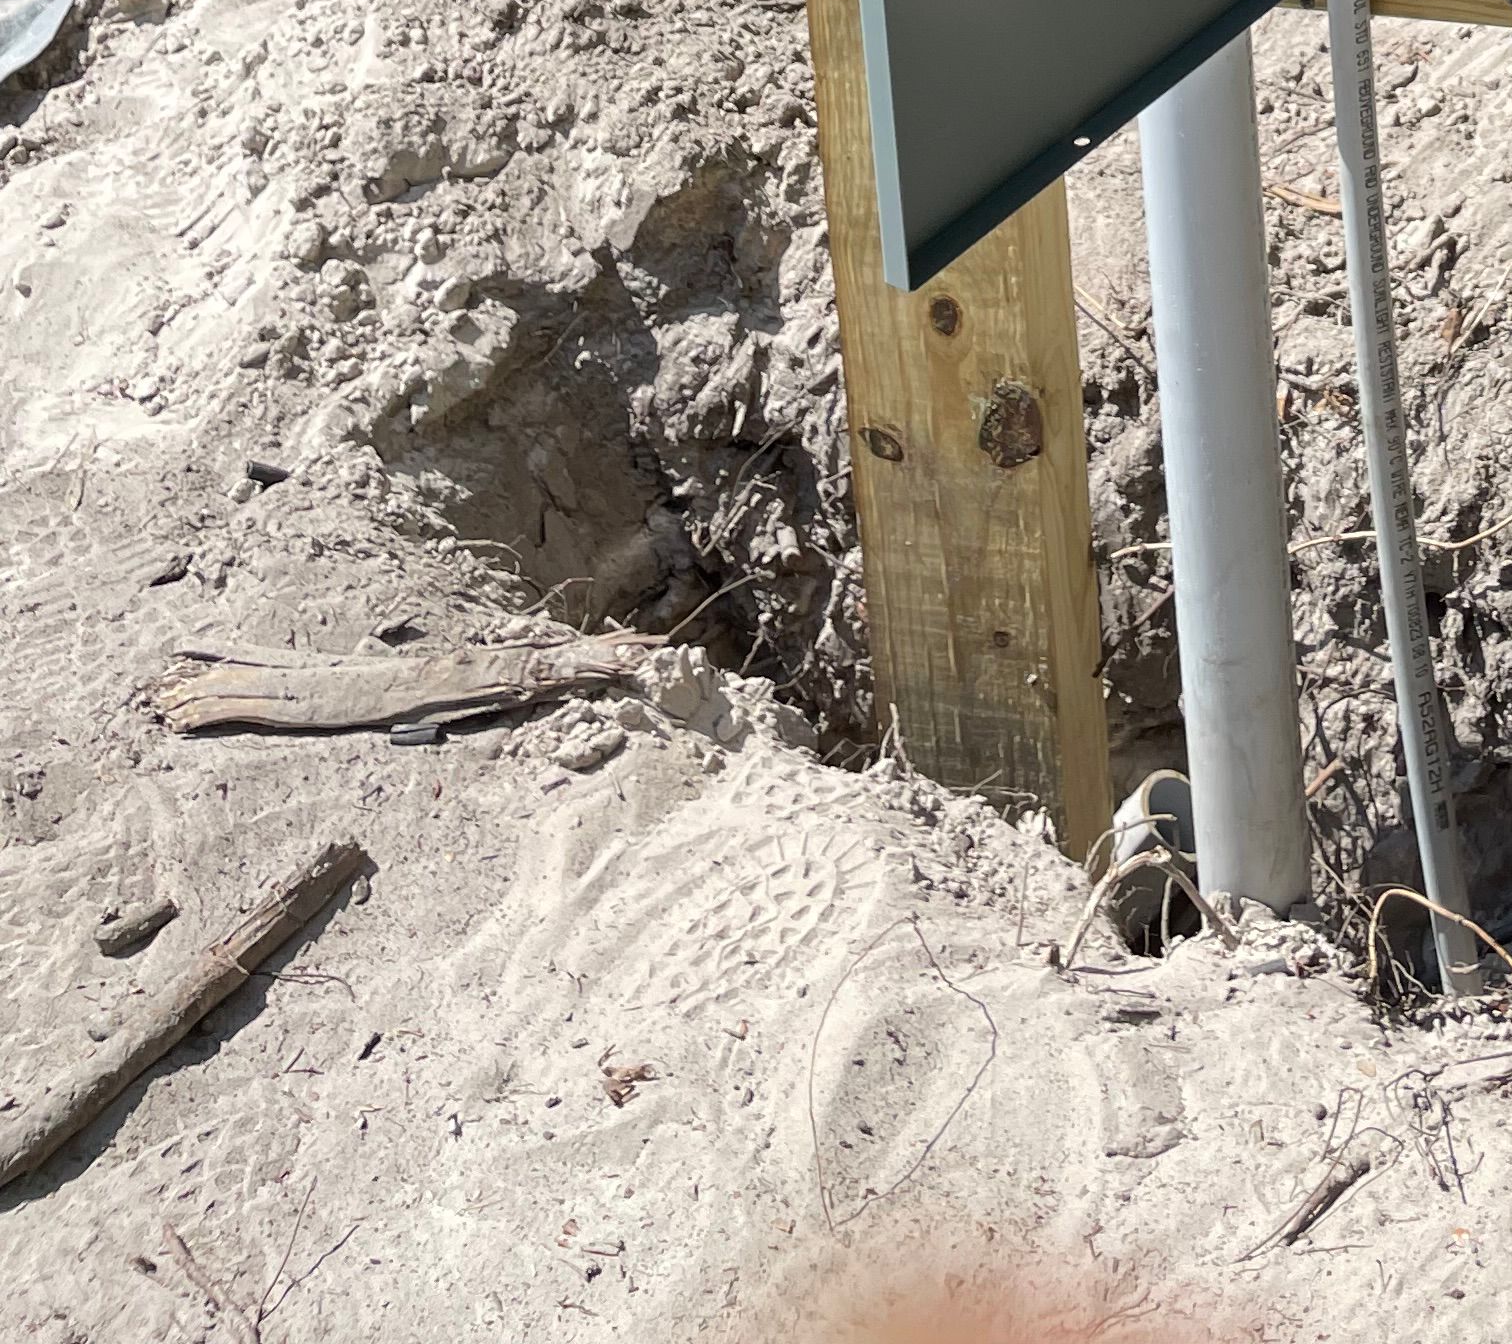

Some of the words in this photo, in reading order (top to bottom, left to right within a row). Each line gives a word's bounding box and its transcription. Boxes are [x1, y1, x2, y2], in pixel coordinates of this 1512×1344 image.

[1354, 19, 1369, 44] STD
[1356, 49, 1370, 72] 651
[1358, 78, 1376, 160] ABOVEGROUND
[1364, 164, 1378, 189] AND
[1366, 193, 1385, 273] UNDERGROUND
[1372, 278, 1390, 334] SUNLIGHT
[1378, 340, 1396, 404] RESISTANT
[1385, 409, 1399, 432] MAX
[1391, 470, 1406, 499] WIRE
[1394, 501, 1410, 532] NEMA
[1398, 536, 1414, 565] TC-2
[1418, 691, 1444, 794] A52AG12H
